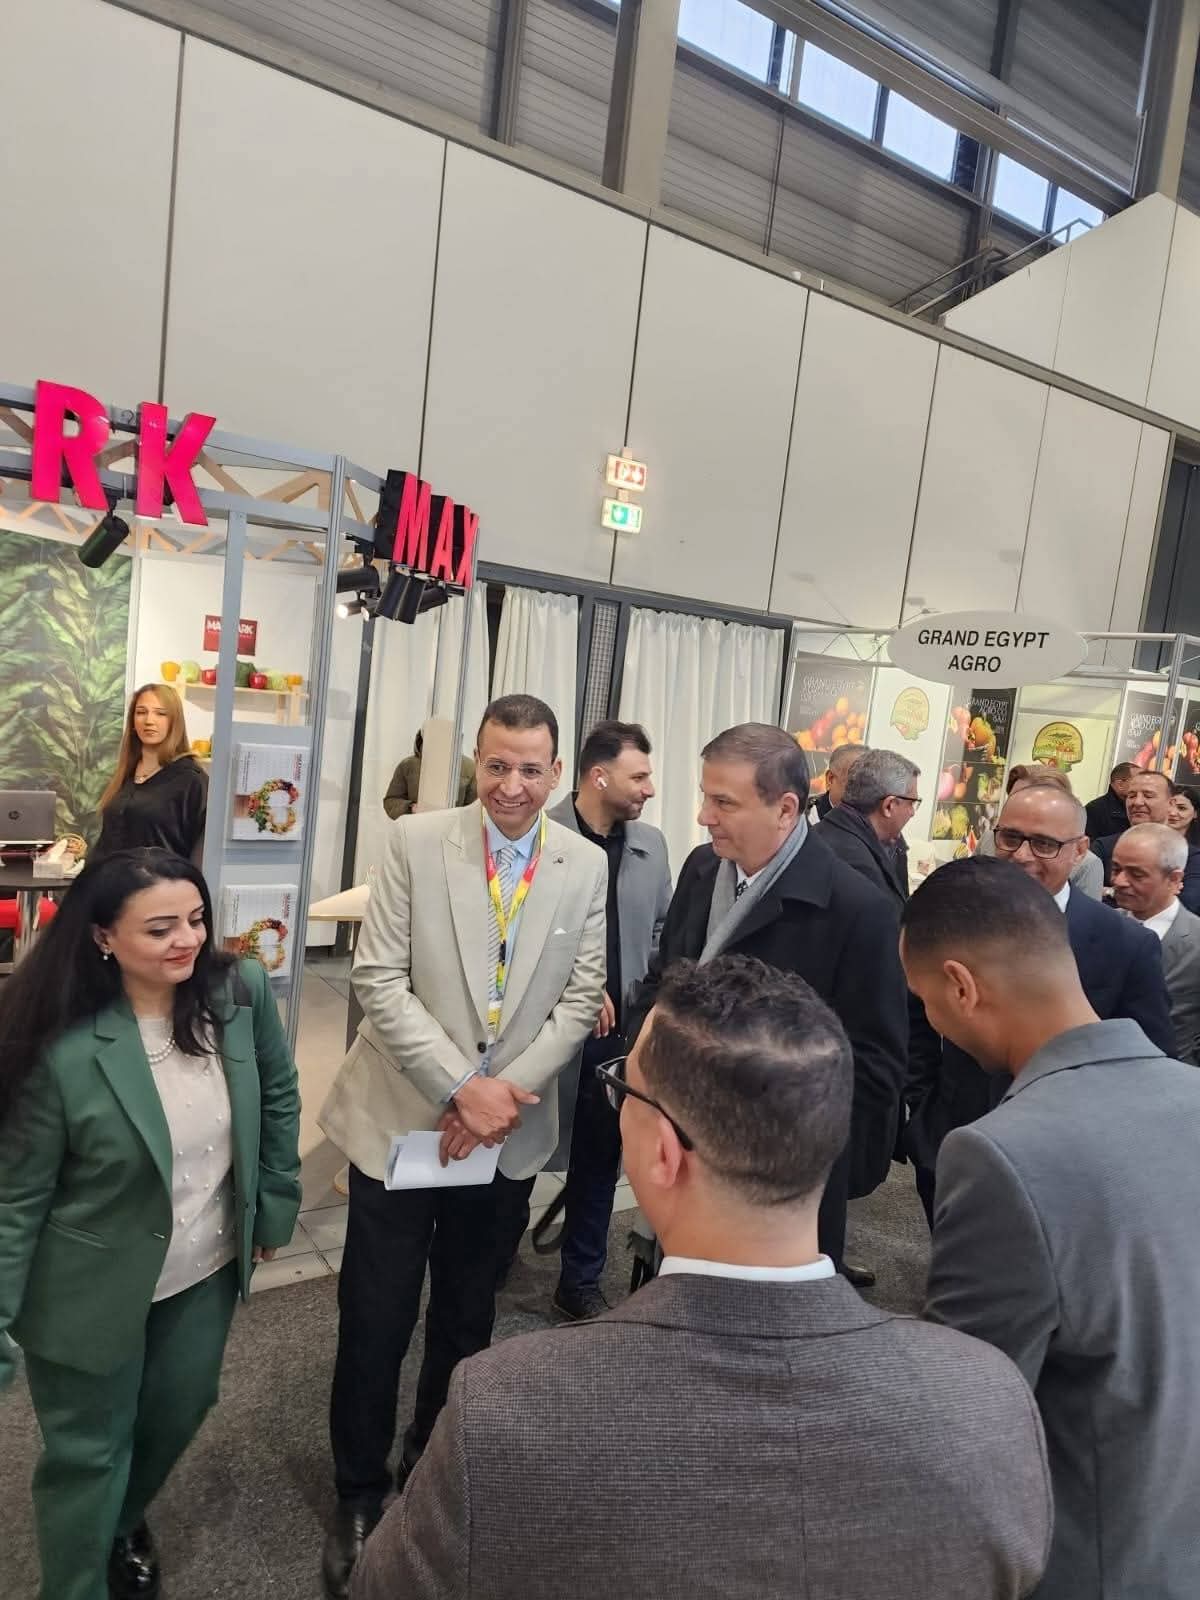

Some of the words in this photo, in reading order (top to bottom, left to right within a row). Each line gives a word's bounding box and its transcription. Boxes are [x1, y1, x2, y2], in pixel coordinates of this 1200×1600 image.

[391, 472, 479, 592] MAX
[918, 630, 980, 647] GRAND
[984, 631, 1050, 649] EGYPT
[947, 654, 1002, 673] AGRO
